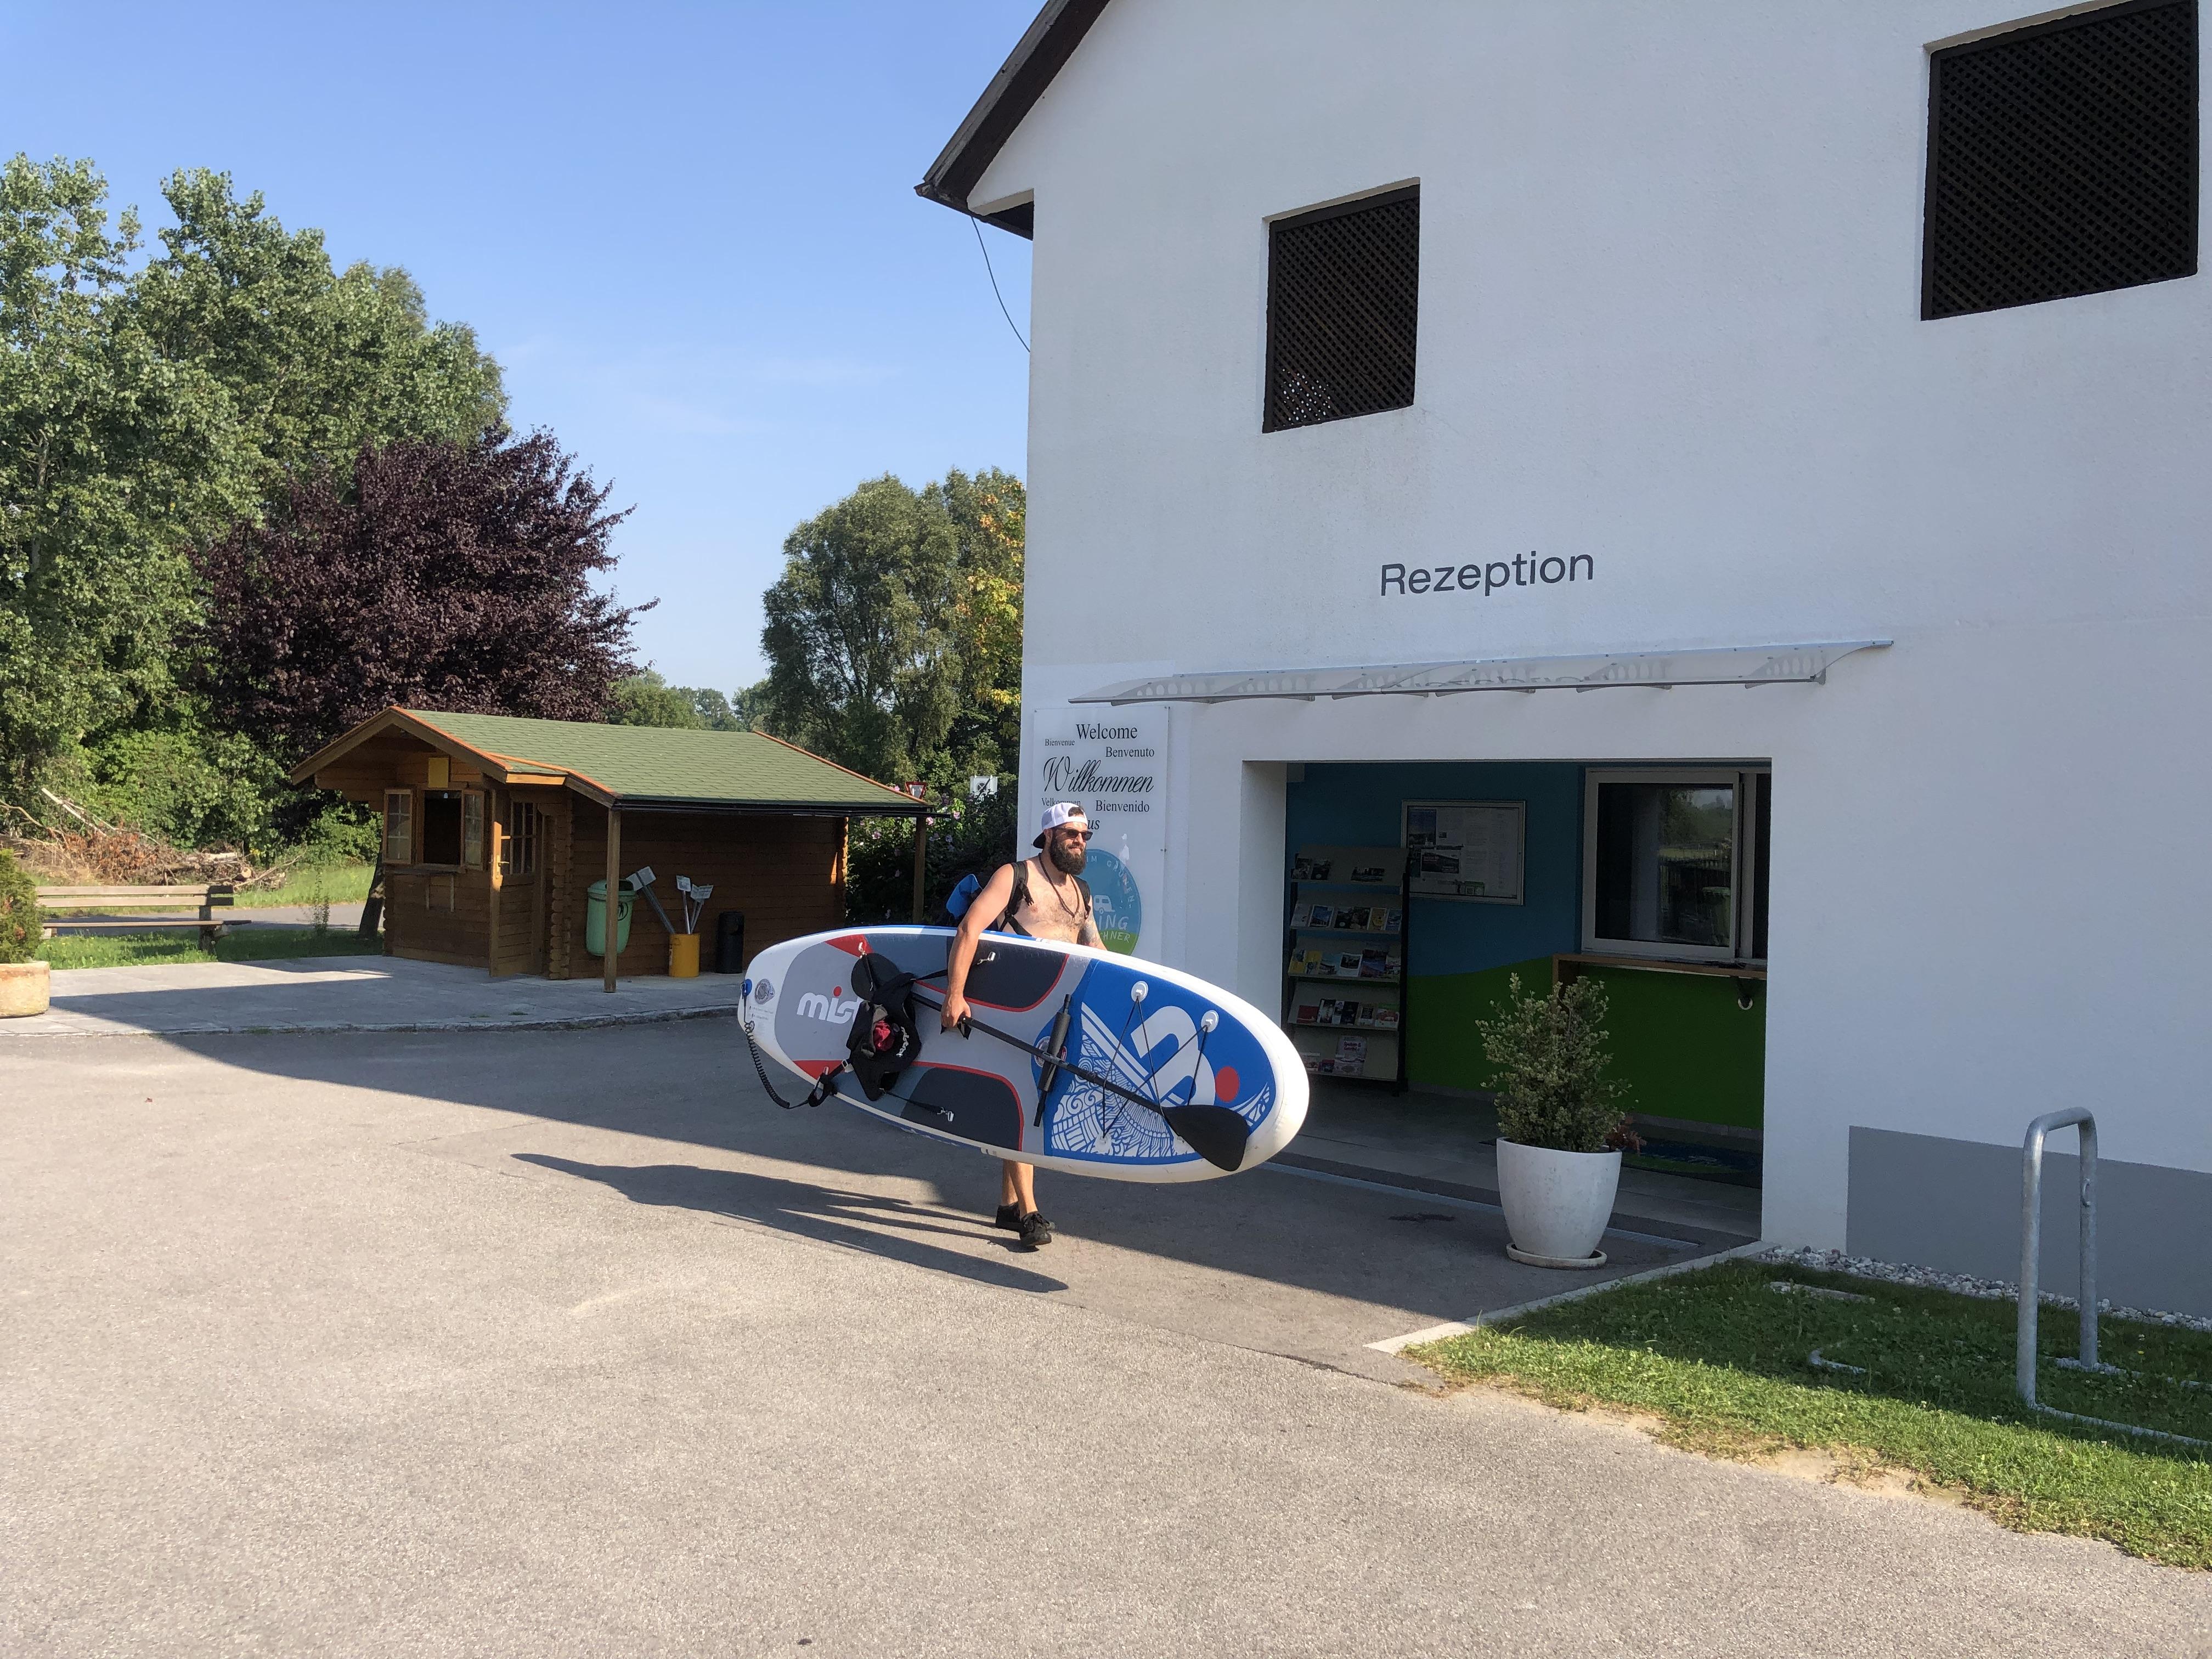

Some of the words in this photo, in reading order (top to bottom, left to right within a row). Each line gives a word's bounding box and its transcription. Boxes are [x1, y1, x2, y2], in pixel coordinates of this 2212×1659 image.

[1381, 550, 1593, 596] Rezeption
[1075, 723, 1138, 740] Welcome
[1105, 746, 1155, 758] Benvenuto
[1043, 755, 1154, 793] Willkommen
[1095, 798, 1150, 813] Bienvenido
